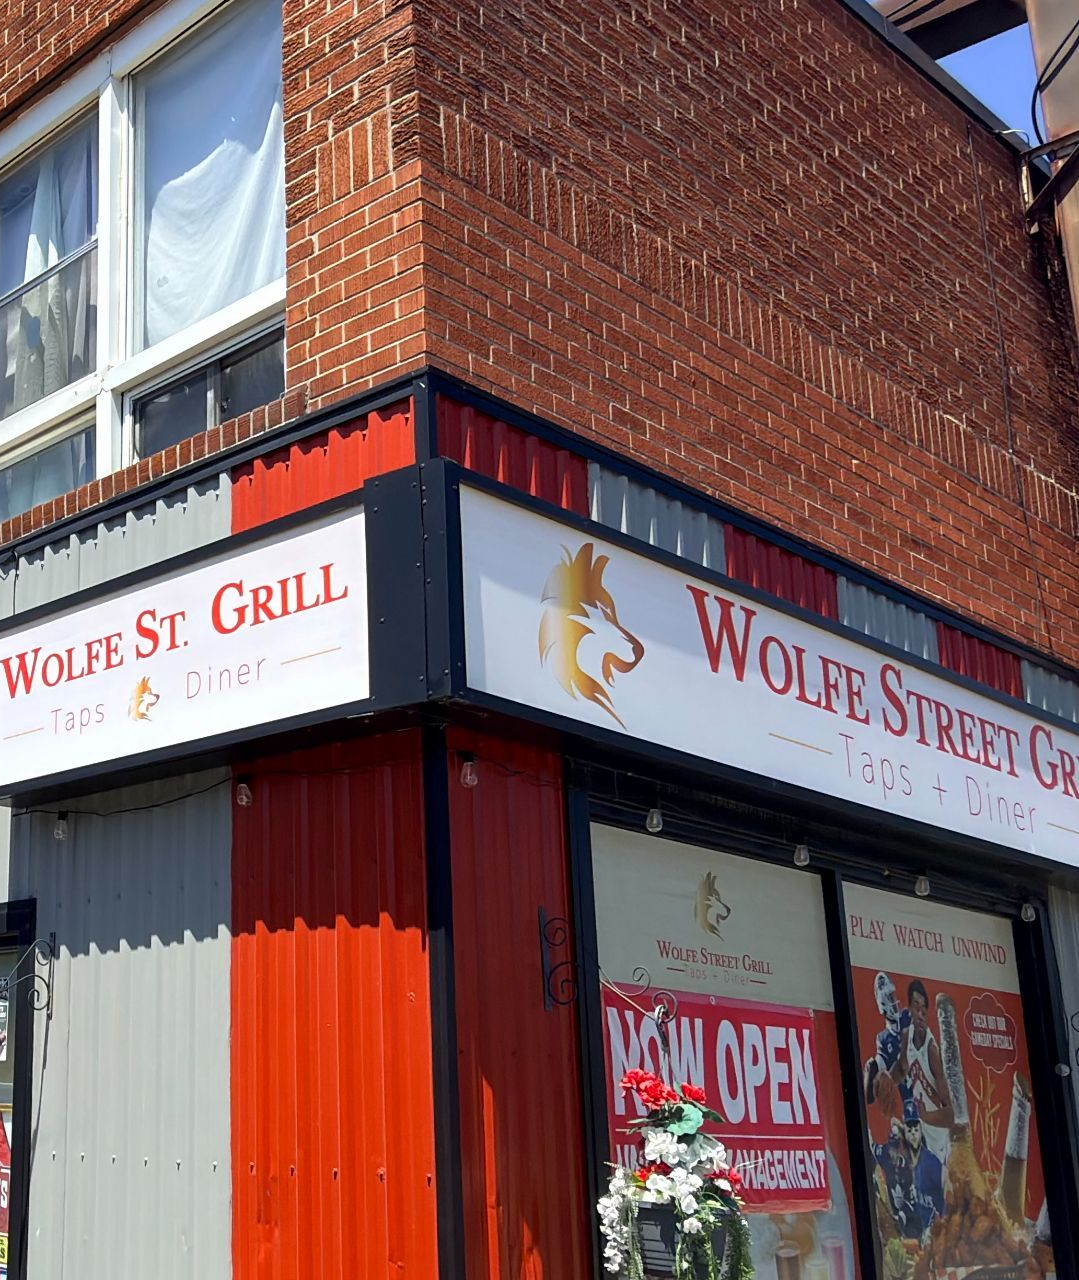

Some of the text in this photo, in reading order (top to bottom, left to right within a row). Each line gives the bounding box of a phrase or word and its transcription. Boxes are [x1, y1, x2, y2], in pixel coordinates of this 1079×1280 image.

[0, 632, 124, 699] WOLFE
[211, 562, 349, 635] GRILL
[50, 658, 267, 735] Taps Diner
[685, 584, 1079, 800] WOLFE STREET GR
[839, 731, 913, 799] Taps
[967, 776, 1037, 834] Diner
[849, 914, 1006, 965] PLAY WATCH UNWIND
[606, 1006, 820, 1125] NOW OPEN
